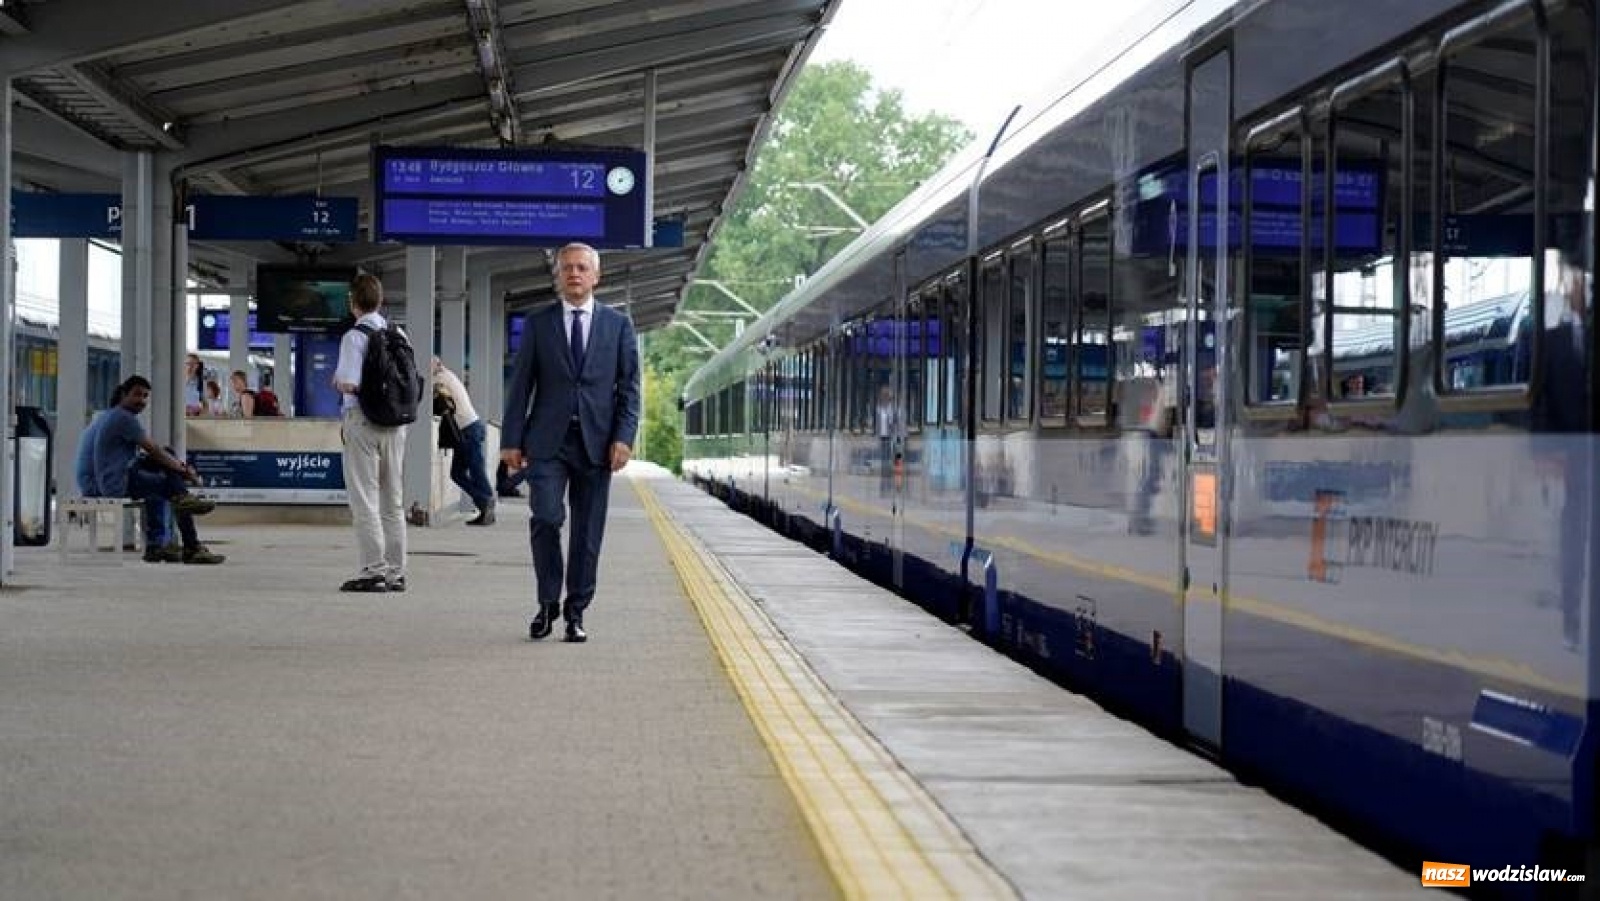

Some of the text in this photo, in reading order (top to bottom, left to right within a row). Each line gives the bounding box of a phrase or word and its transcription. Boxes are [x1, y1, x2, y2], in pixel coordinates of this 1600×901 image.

[570, 169, 595, 189] 12
[185, 204, 197, 231] 1
[312, 210, 330, 223] 12
[275, 454, 331, 471] wyjście
